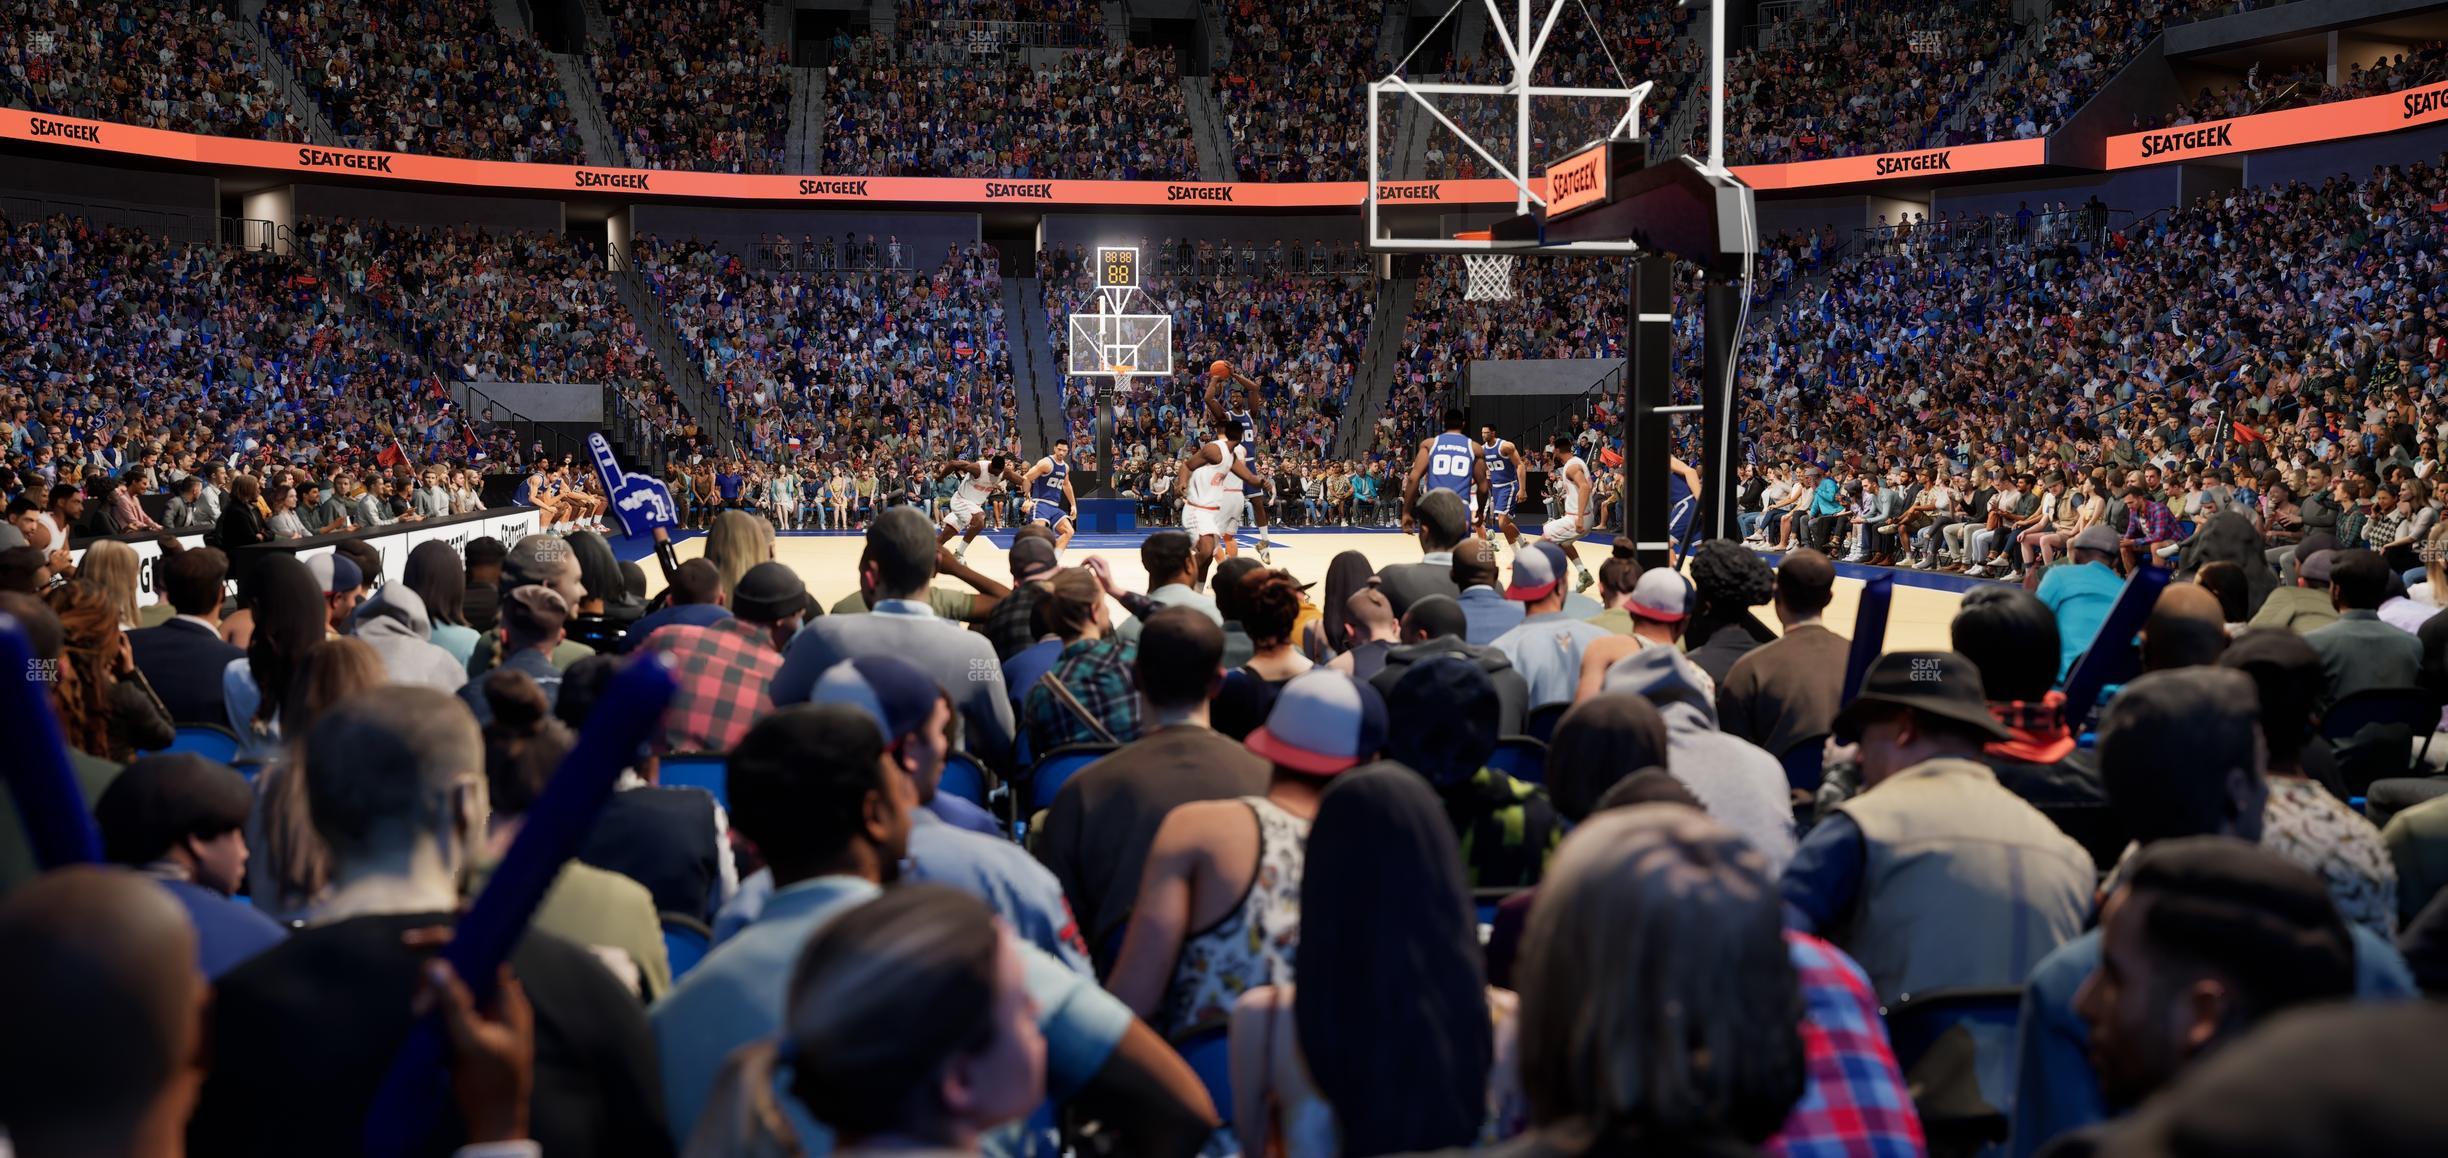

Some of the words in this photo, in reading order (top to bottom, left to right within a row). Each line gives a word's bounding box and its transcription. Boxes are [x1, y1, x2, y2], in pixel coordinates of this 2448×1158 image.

[30, 117, 101, 144] SEATGEEK
[2141, 122, 2232, 158] SEATGEEK
[299, 148, 392, 173] SEATGEEK
[1876, 150, 1951, 176] SEATGEEK
[575, 170, 649, 190] SEATGEEK
[799, 179, 868, 196] SEATGEEK
[985, 182, 1053, 199] SEATGEEK
[1553, 157, 1598, 205] SEATGEEK
[1167, 185, 1233, 202] SEATGEEK
[1105, 251, 1118, 263] 88
[1119, 251, 1132, 263] 88
[1108, 265, 1129, 284] 88
[1432, 454, 1470, 477] 00
